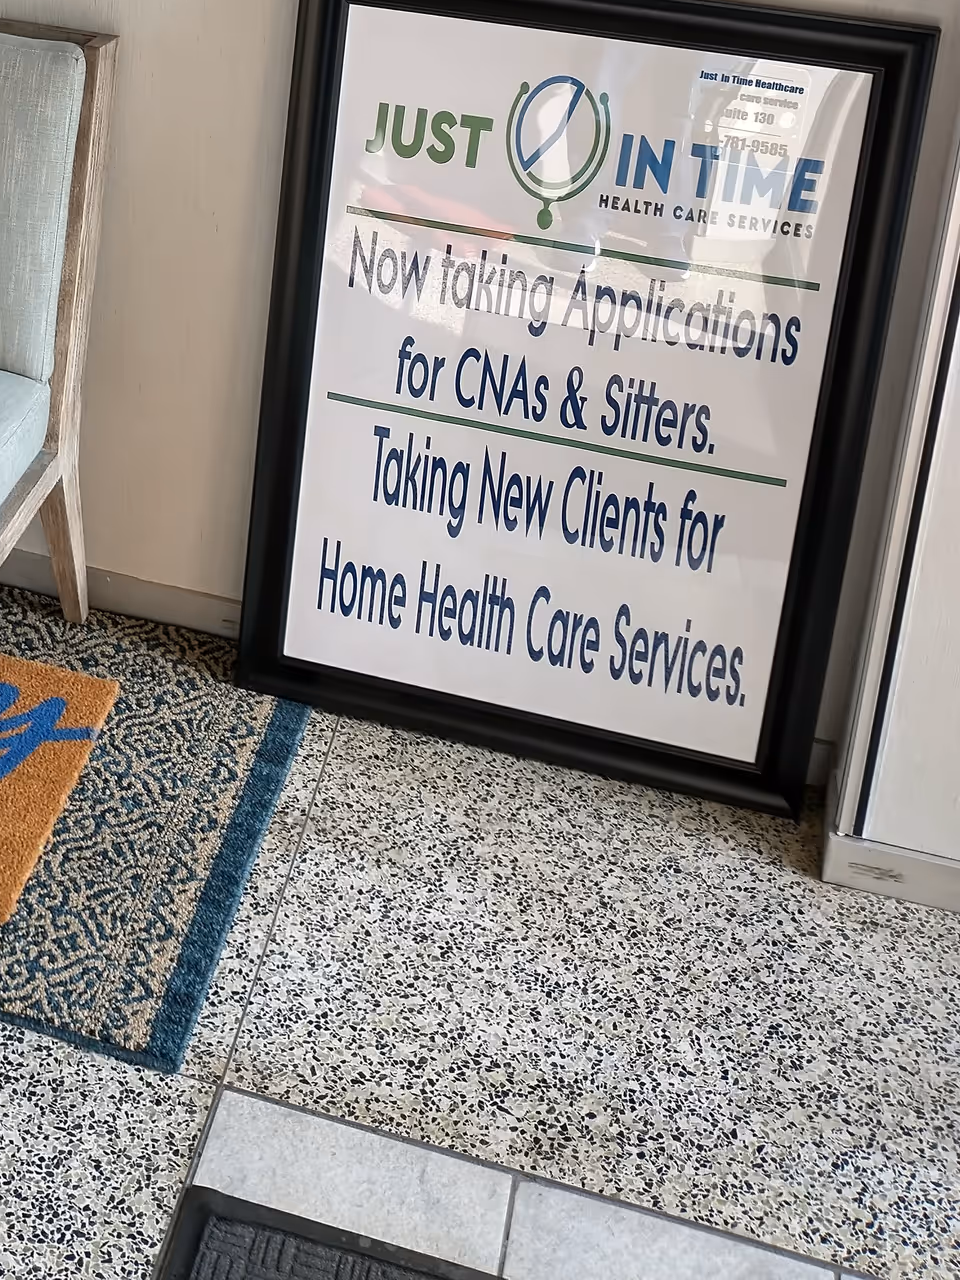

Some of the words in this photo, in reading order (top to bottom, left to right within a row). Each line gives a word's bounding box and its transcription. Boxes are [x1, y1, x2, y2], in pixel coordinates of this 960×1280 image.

[699, 70, 718, 81] Just
[720, 74, 730, 83] In
[732, 75, 754, 86] Time
[754, 78, 805, 95] Healthcare
[721, 108, 748, 120] uite
[754, 112, 775, 126] 130
[740, 93, 762, 104] care
[763, 96, 799, 110] service
[365, 102, 494, 168] JUST
[615, 133, 676, 195] IN
[691, 143, 825, 215] TIME
[599, 194, 664, 217] HEALTH
[673, 206, 718, 225] CARE
[726, 214, 814, 239] SERVICES
[348, 225, 431, 303] Now
[439, 244, 555, 337] taking
[561, 264, 801, 366] Applications
[395, 335, 446, 401] for
[454, 347, 549, 422] CNAs
[559, 366, 587, 430] &
[601, 374, 715, 454] Sitters.
[372, 425, 471, 538] Taking
[477, 445, 555, 540] New
[561, 466, 667, 563] Clients
[675, 489, 726, 573] for
[317, 537, 407, 629] Home
[415, 560, 515, 655] Health
[526, 585, 600, 674] Care
[609, 604, 745, 707] Services.
